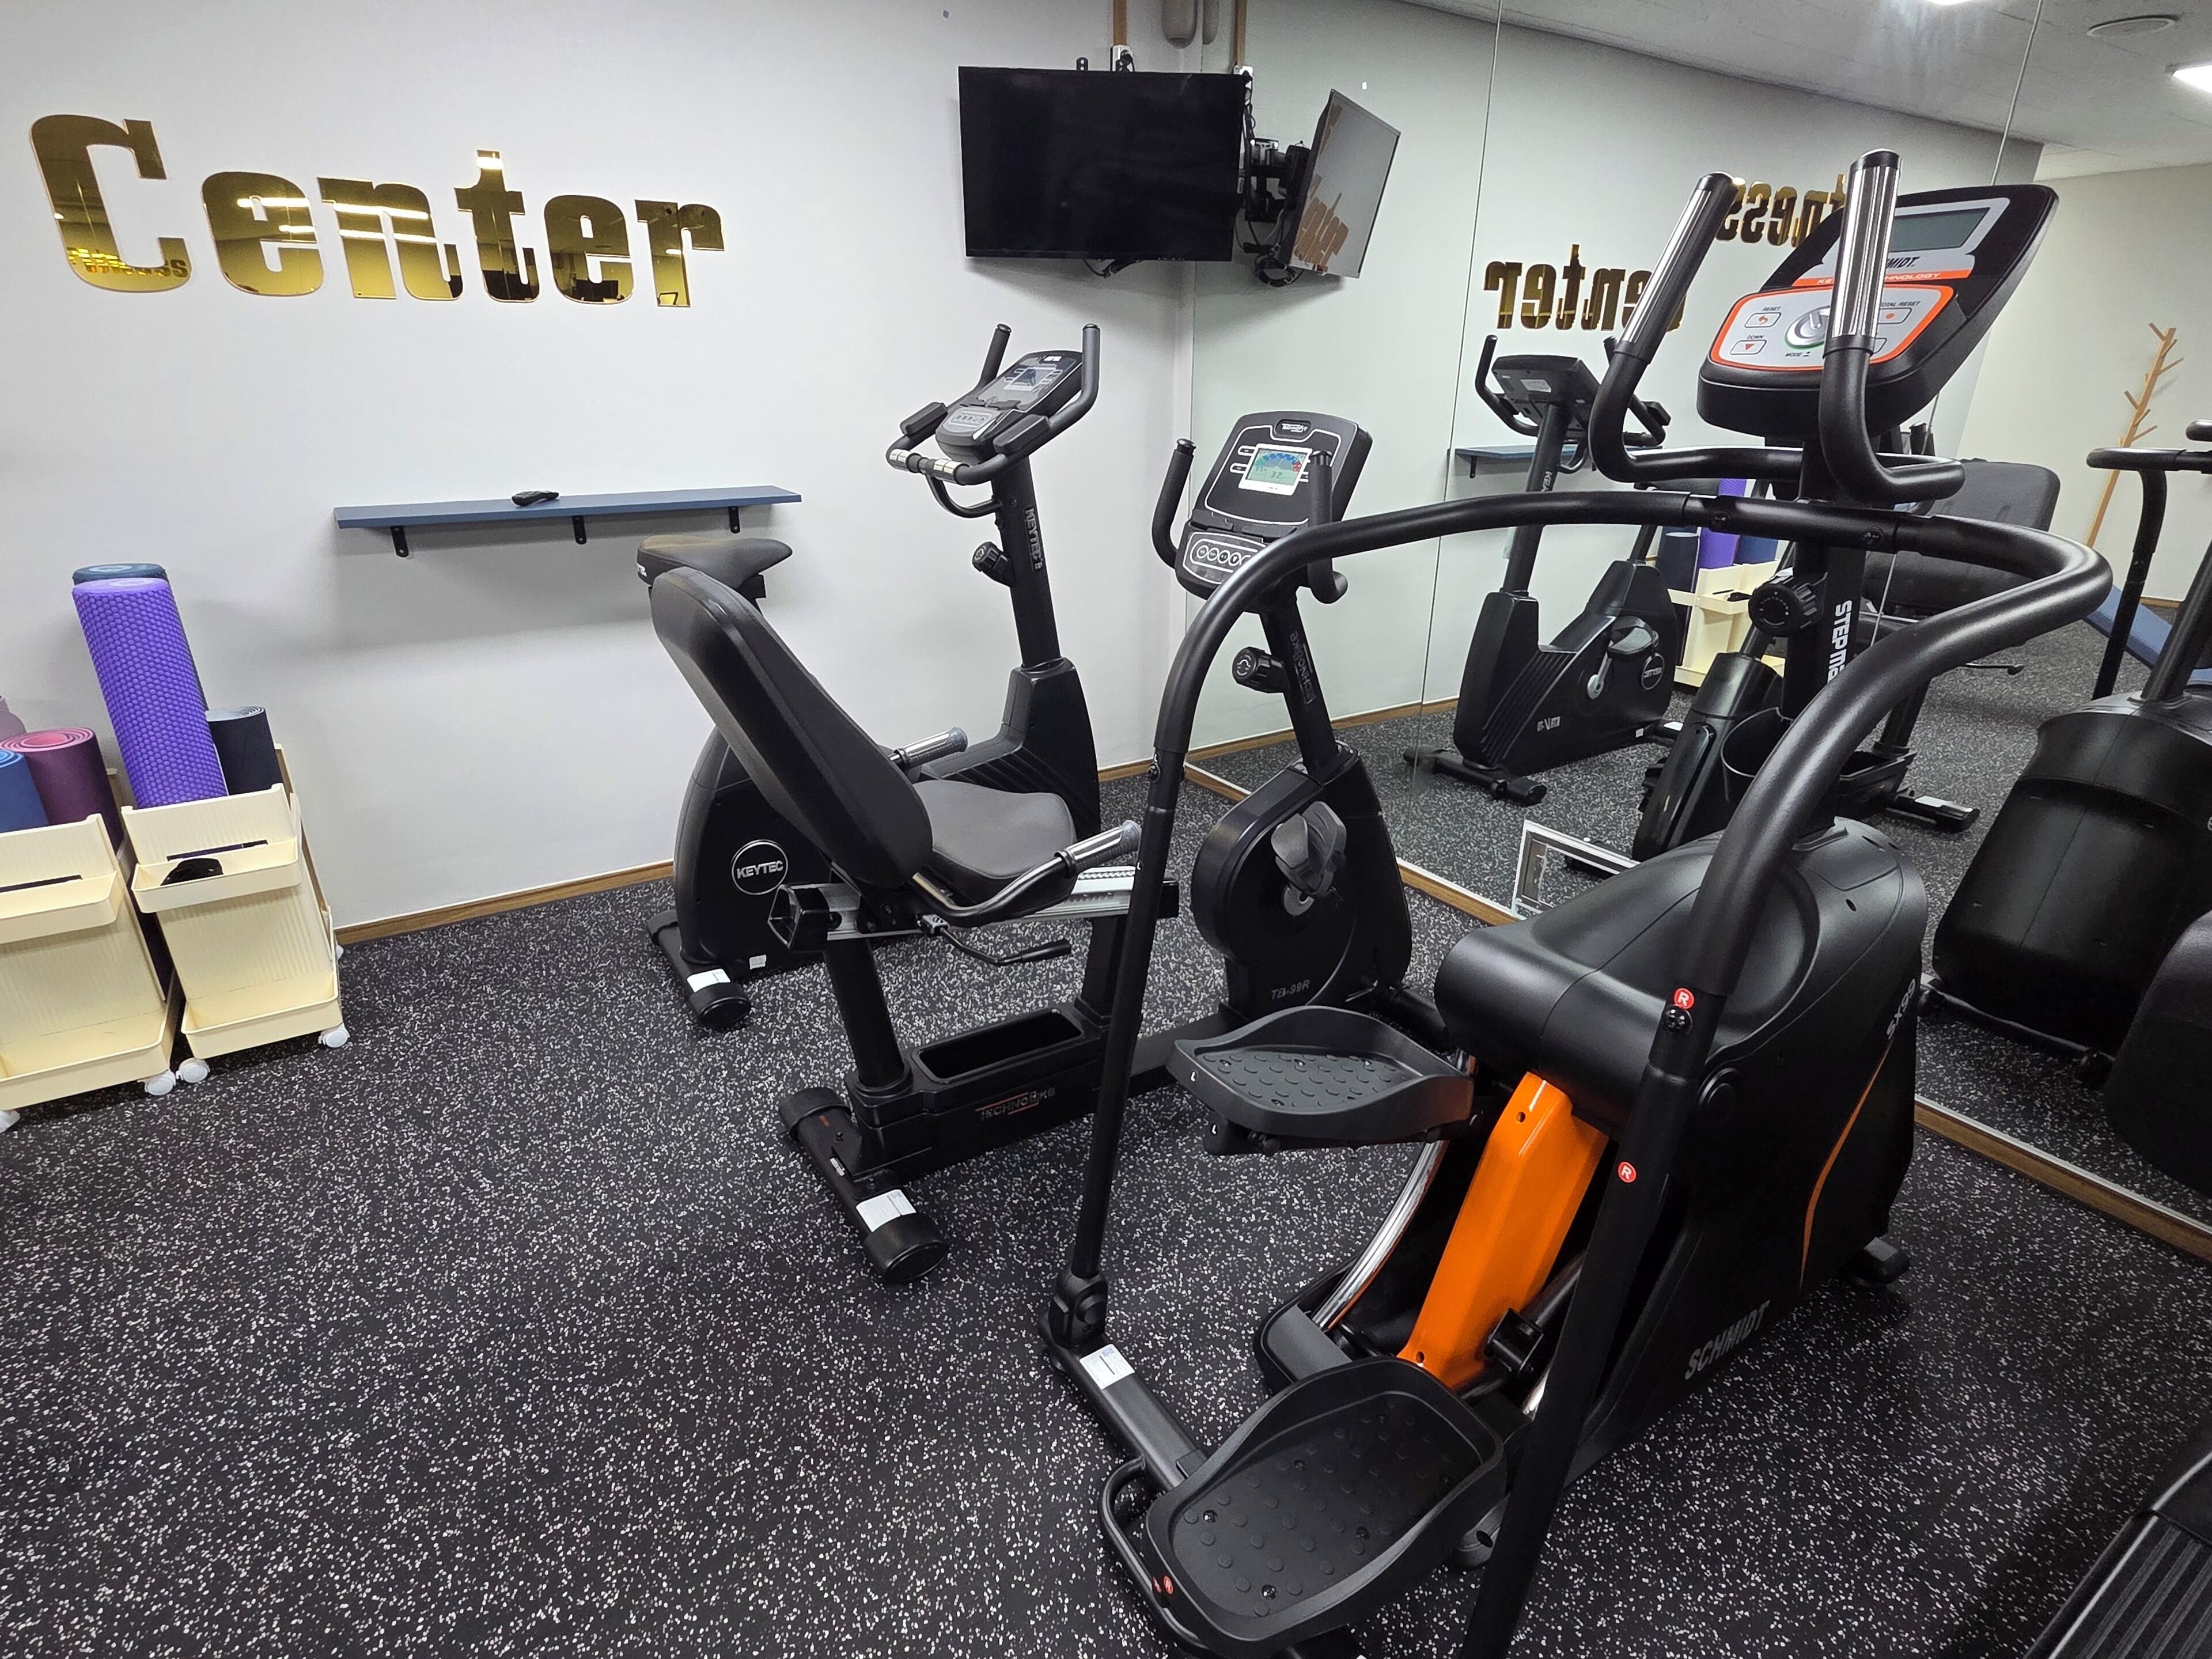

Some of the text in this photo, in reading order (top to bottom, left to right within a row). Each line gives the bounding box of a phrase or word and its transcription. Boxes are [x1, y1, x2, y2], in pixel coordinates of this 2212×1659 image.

[29, 114, 725, 308] Center
[736, 860, 784, 879] KEYTEC
[1271, 979, 1310, 1000] TB-99R
[1886, 978, 1916, 1040] SX99
[1684, 1299, 1771, 1380] SCHMIDT
